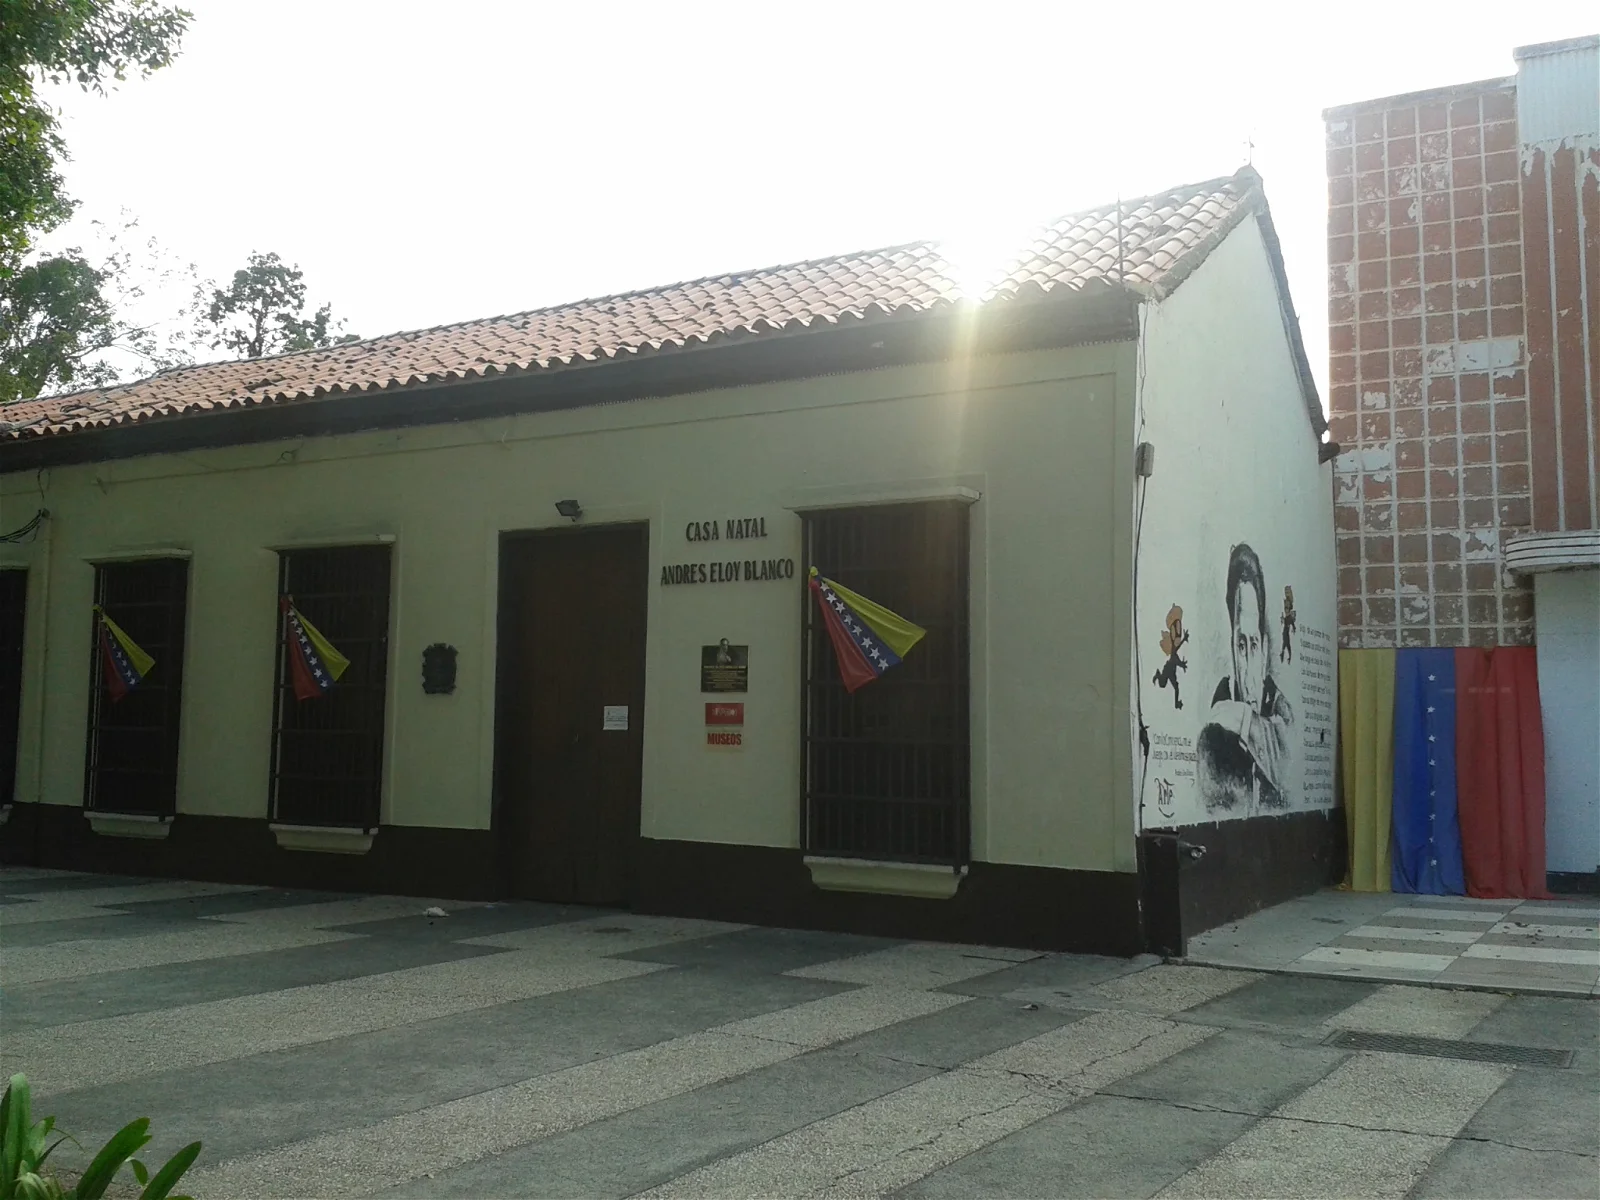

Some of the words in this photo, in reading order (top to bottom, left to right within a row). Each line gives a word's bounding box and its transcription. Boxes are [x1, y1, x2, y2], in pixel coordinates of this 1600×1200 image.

[685, 520, 719, 542] CASA
[726, 517, 768, 540] NATAL
[661, 563, 707, 587] ANDRES
[709, 561, 741, 583] ELOY
[744, 558, 794, 581] BLANCO
[707, 732, 742, 745] MUSEOS
